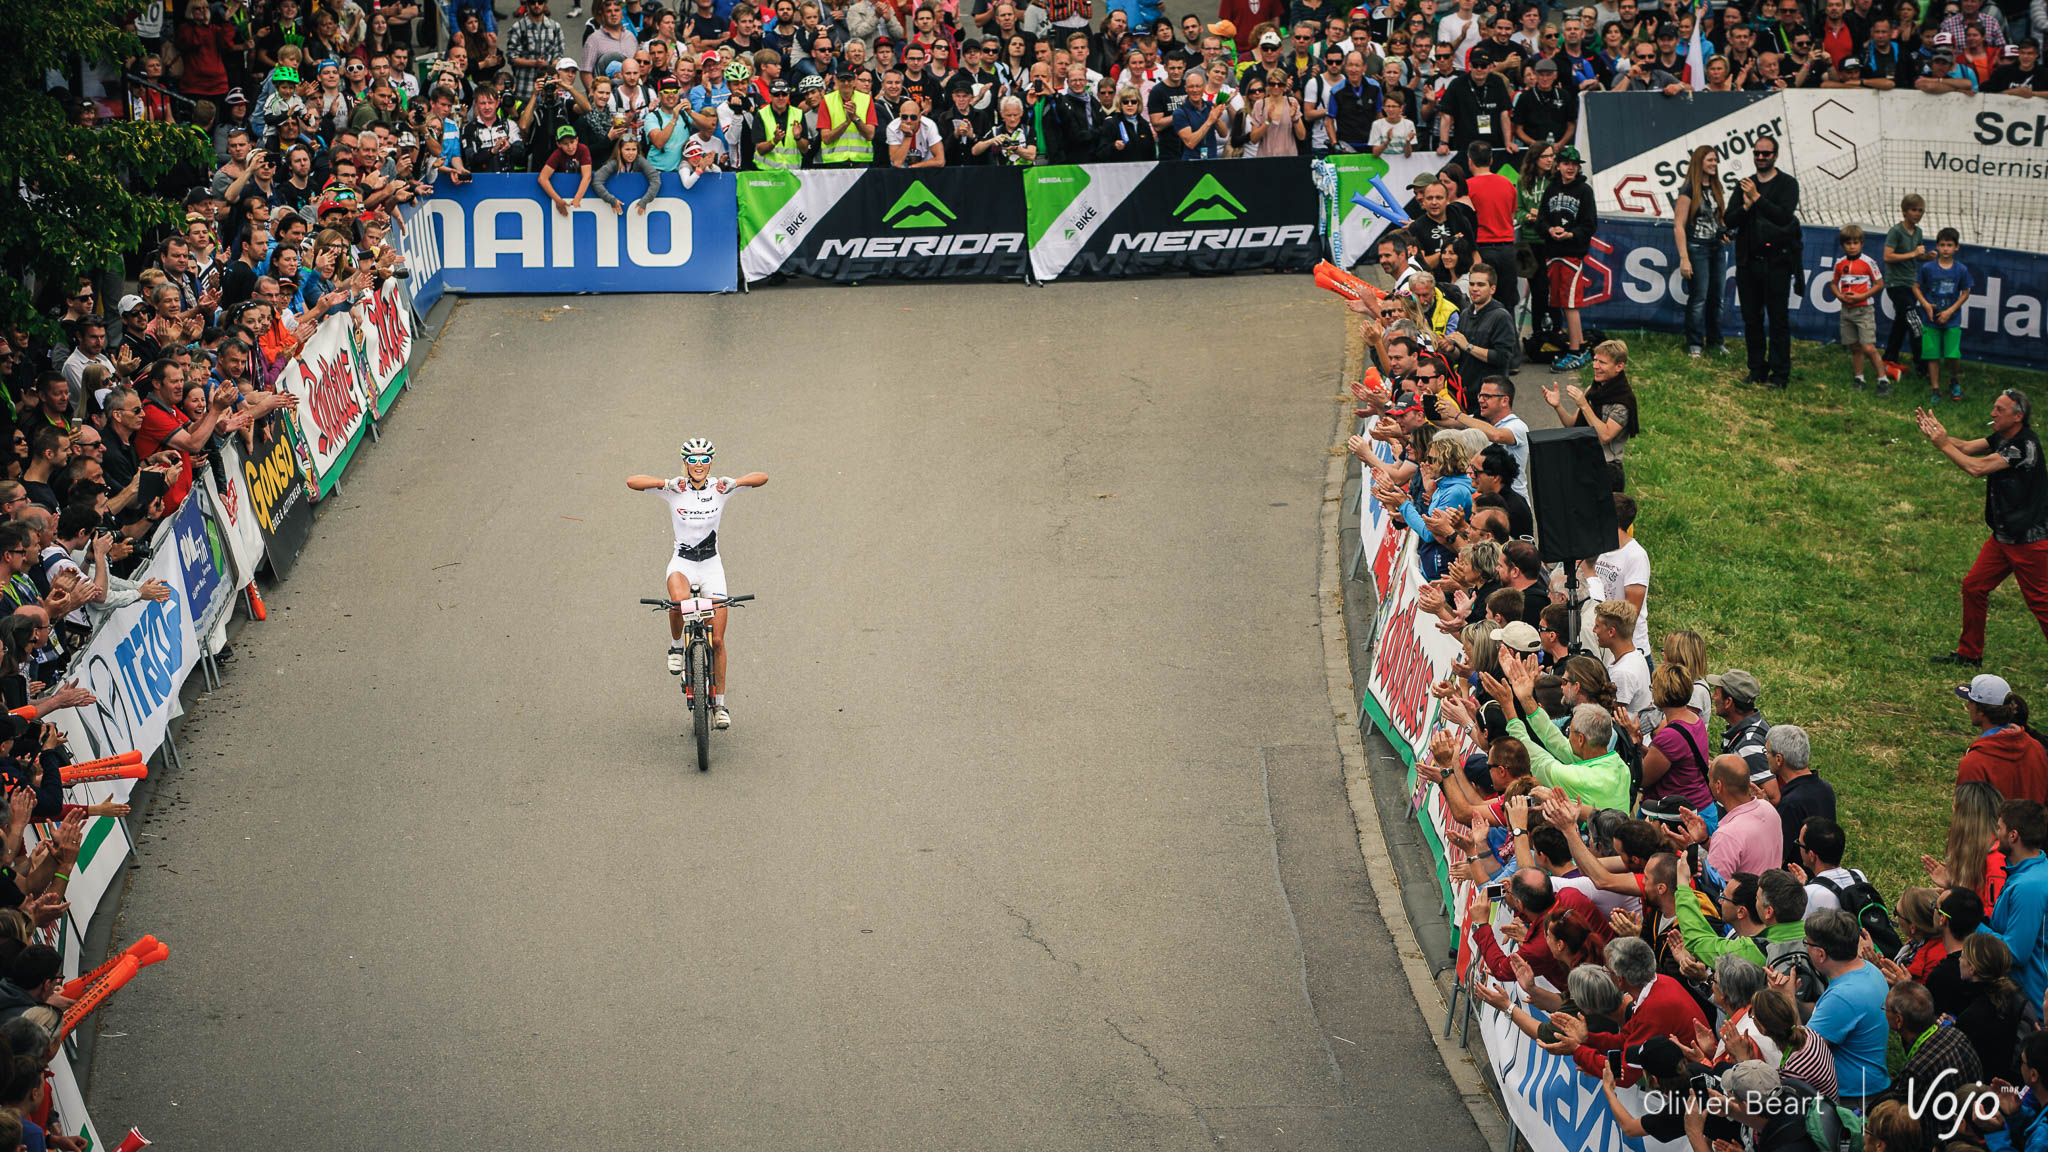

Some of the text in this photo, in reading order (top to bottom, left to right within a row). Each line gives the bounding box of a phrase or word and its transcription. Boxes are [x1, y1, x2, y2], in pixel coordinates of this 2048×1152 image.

[786, 212, 807, 236] BIKE
[1075, 206, 1097, 231] BIKE
[816, 232, 1025, 260] MERIDA
[1106, 224, 1314, 254] MERIDA
[694, 600, 699, 610] 1
